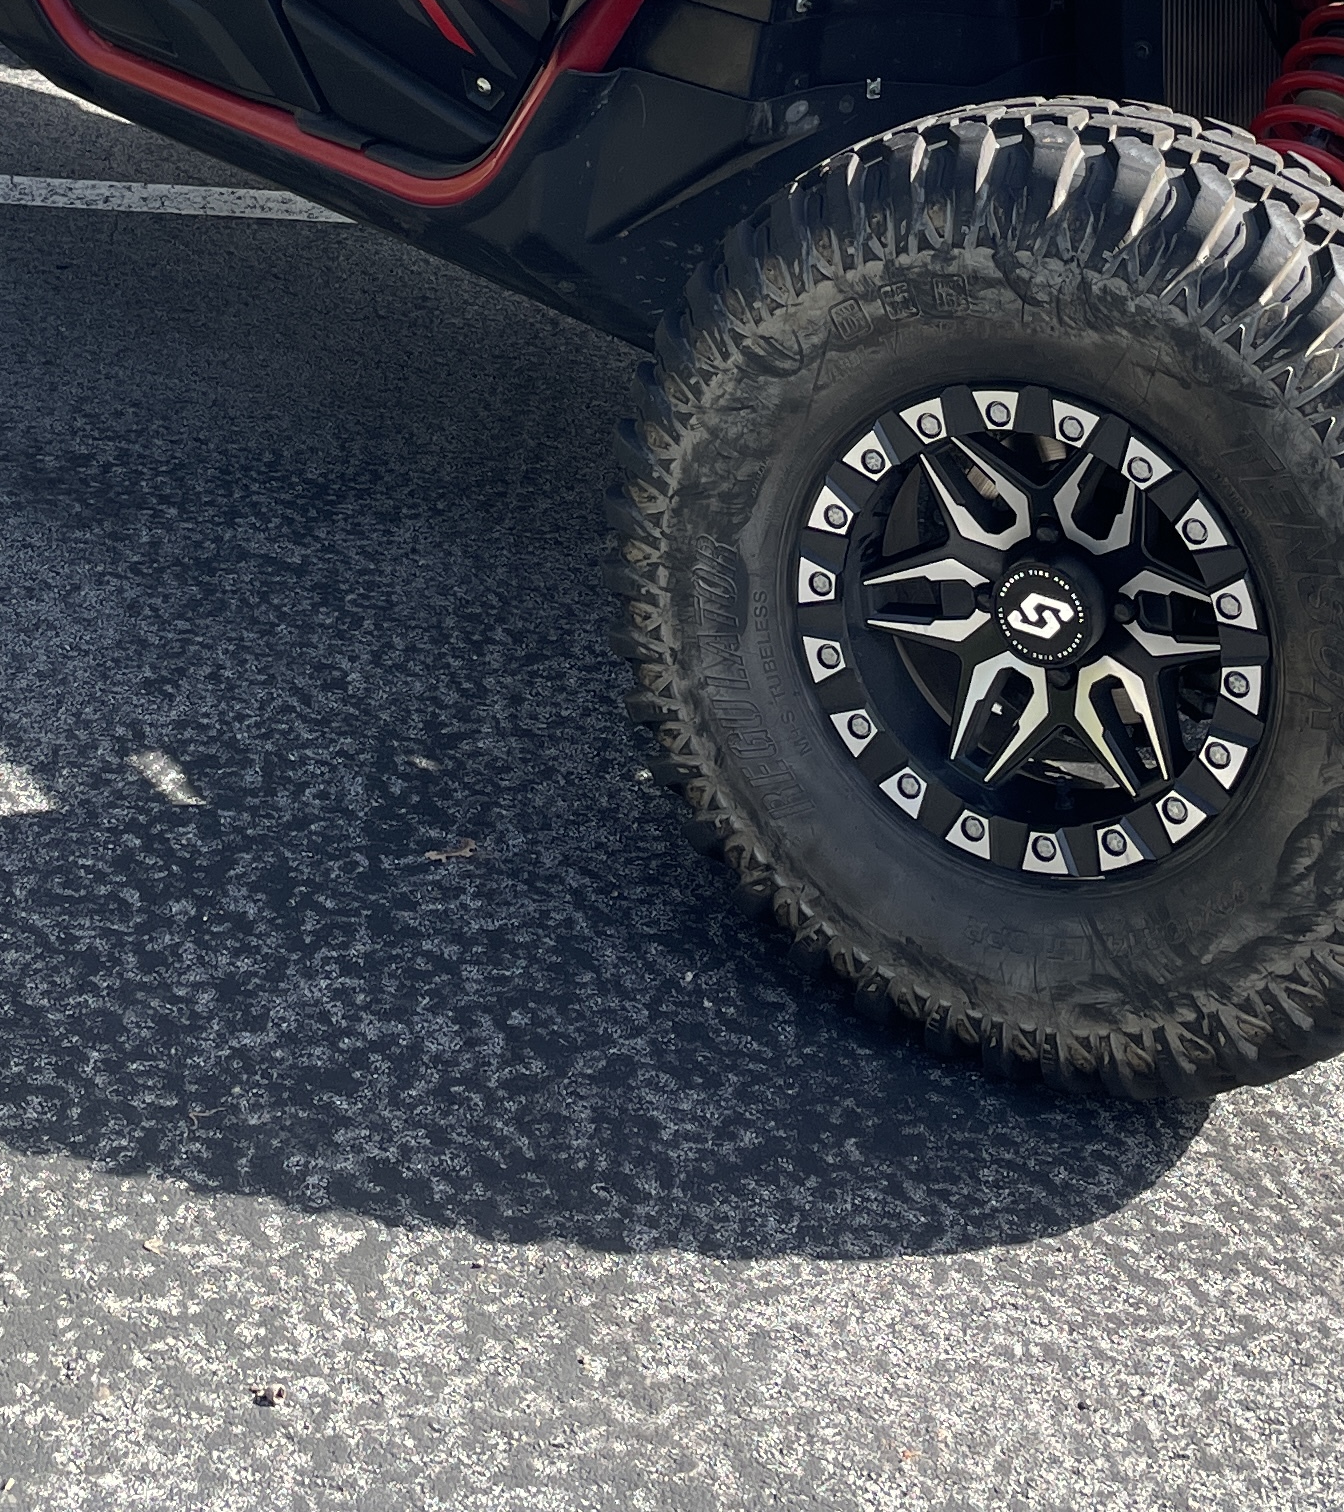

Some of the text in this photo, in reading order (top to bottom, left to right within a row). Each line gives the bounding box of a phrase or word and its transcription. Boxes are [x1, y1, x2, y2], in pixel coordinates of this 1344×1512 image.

[1028, 569, 1050, 578] TIRE
[692, 534, 816, 820] REGULATOR
[754, 591, 785, 704] TUBELESS
